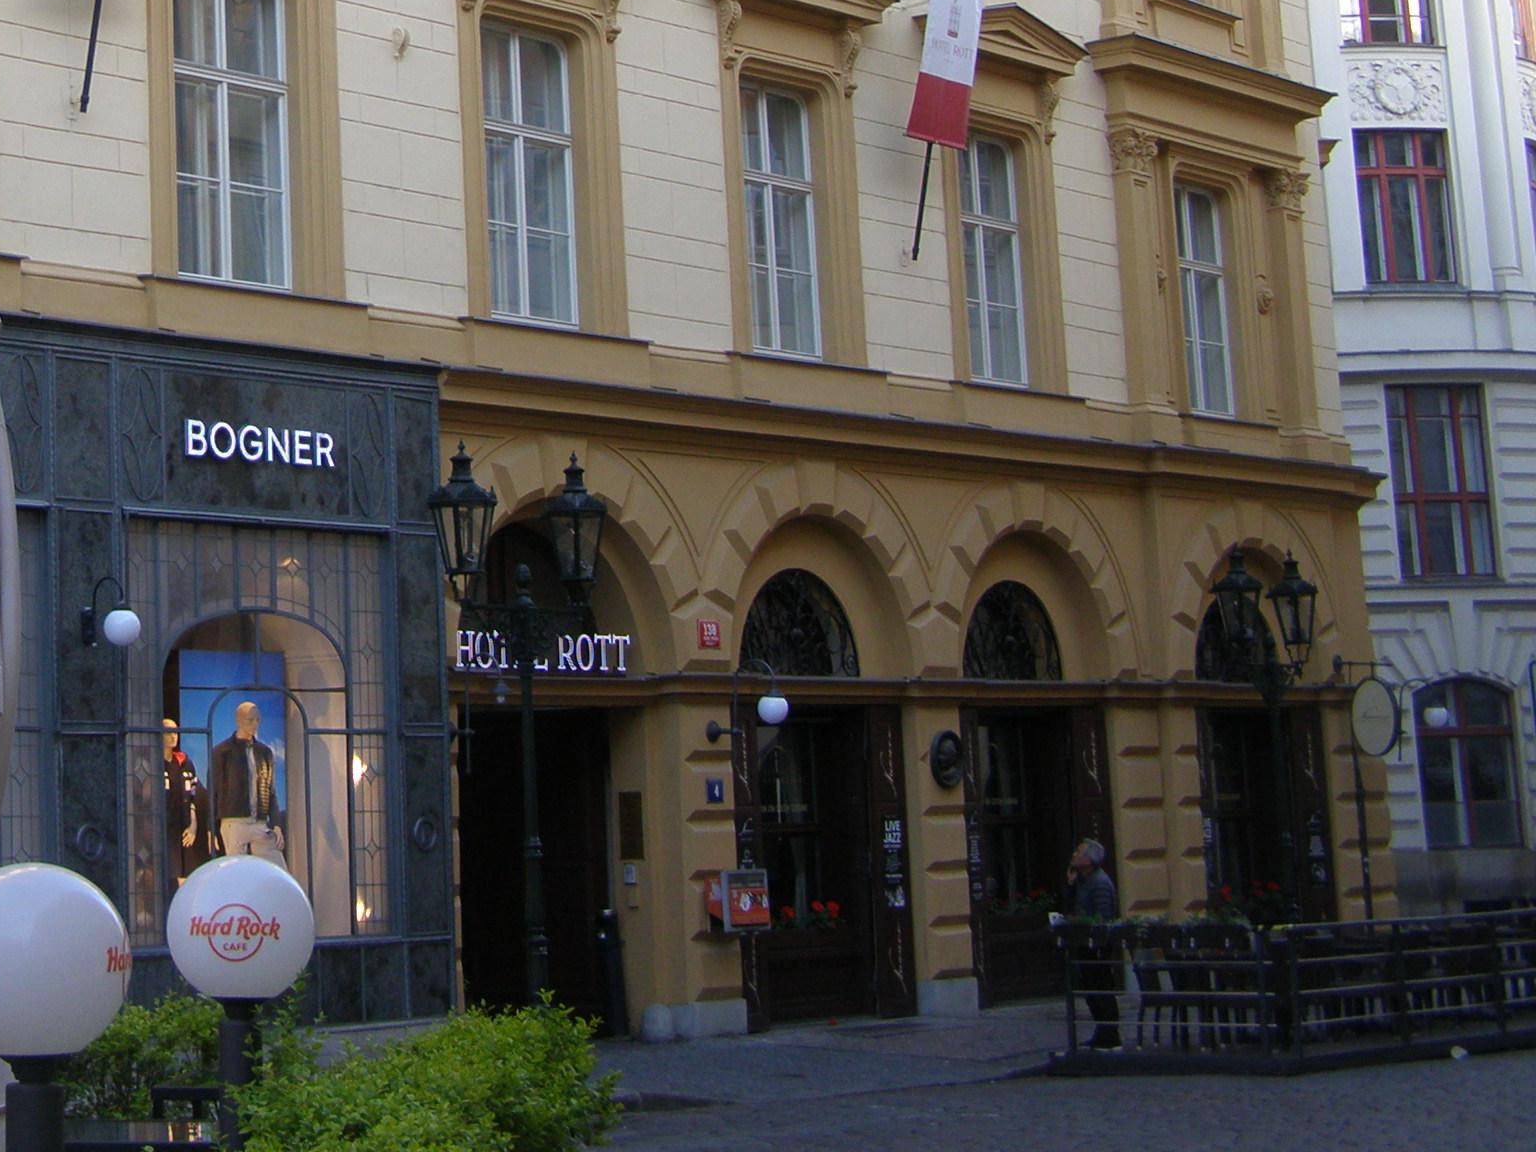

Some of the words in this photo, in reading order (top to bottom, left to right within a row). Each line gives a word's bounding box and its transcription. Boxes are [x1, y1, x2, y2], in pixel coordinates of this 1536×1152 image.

[186, 418, 335, 468] BOGNER
[556, 633, 631, 672] ROTT
[884, 819, 901, 832] LIVE
[883, 832, 902, 843] JAZZ
[190, 916, 234, 937] Hard
[236, 915, 281, 940] Rock
[223, 942, 248, 951] CAFE
